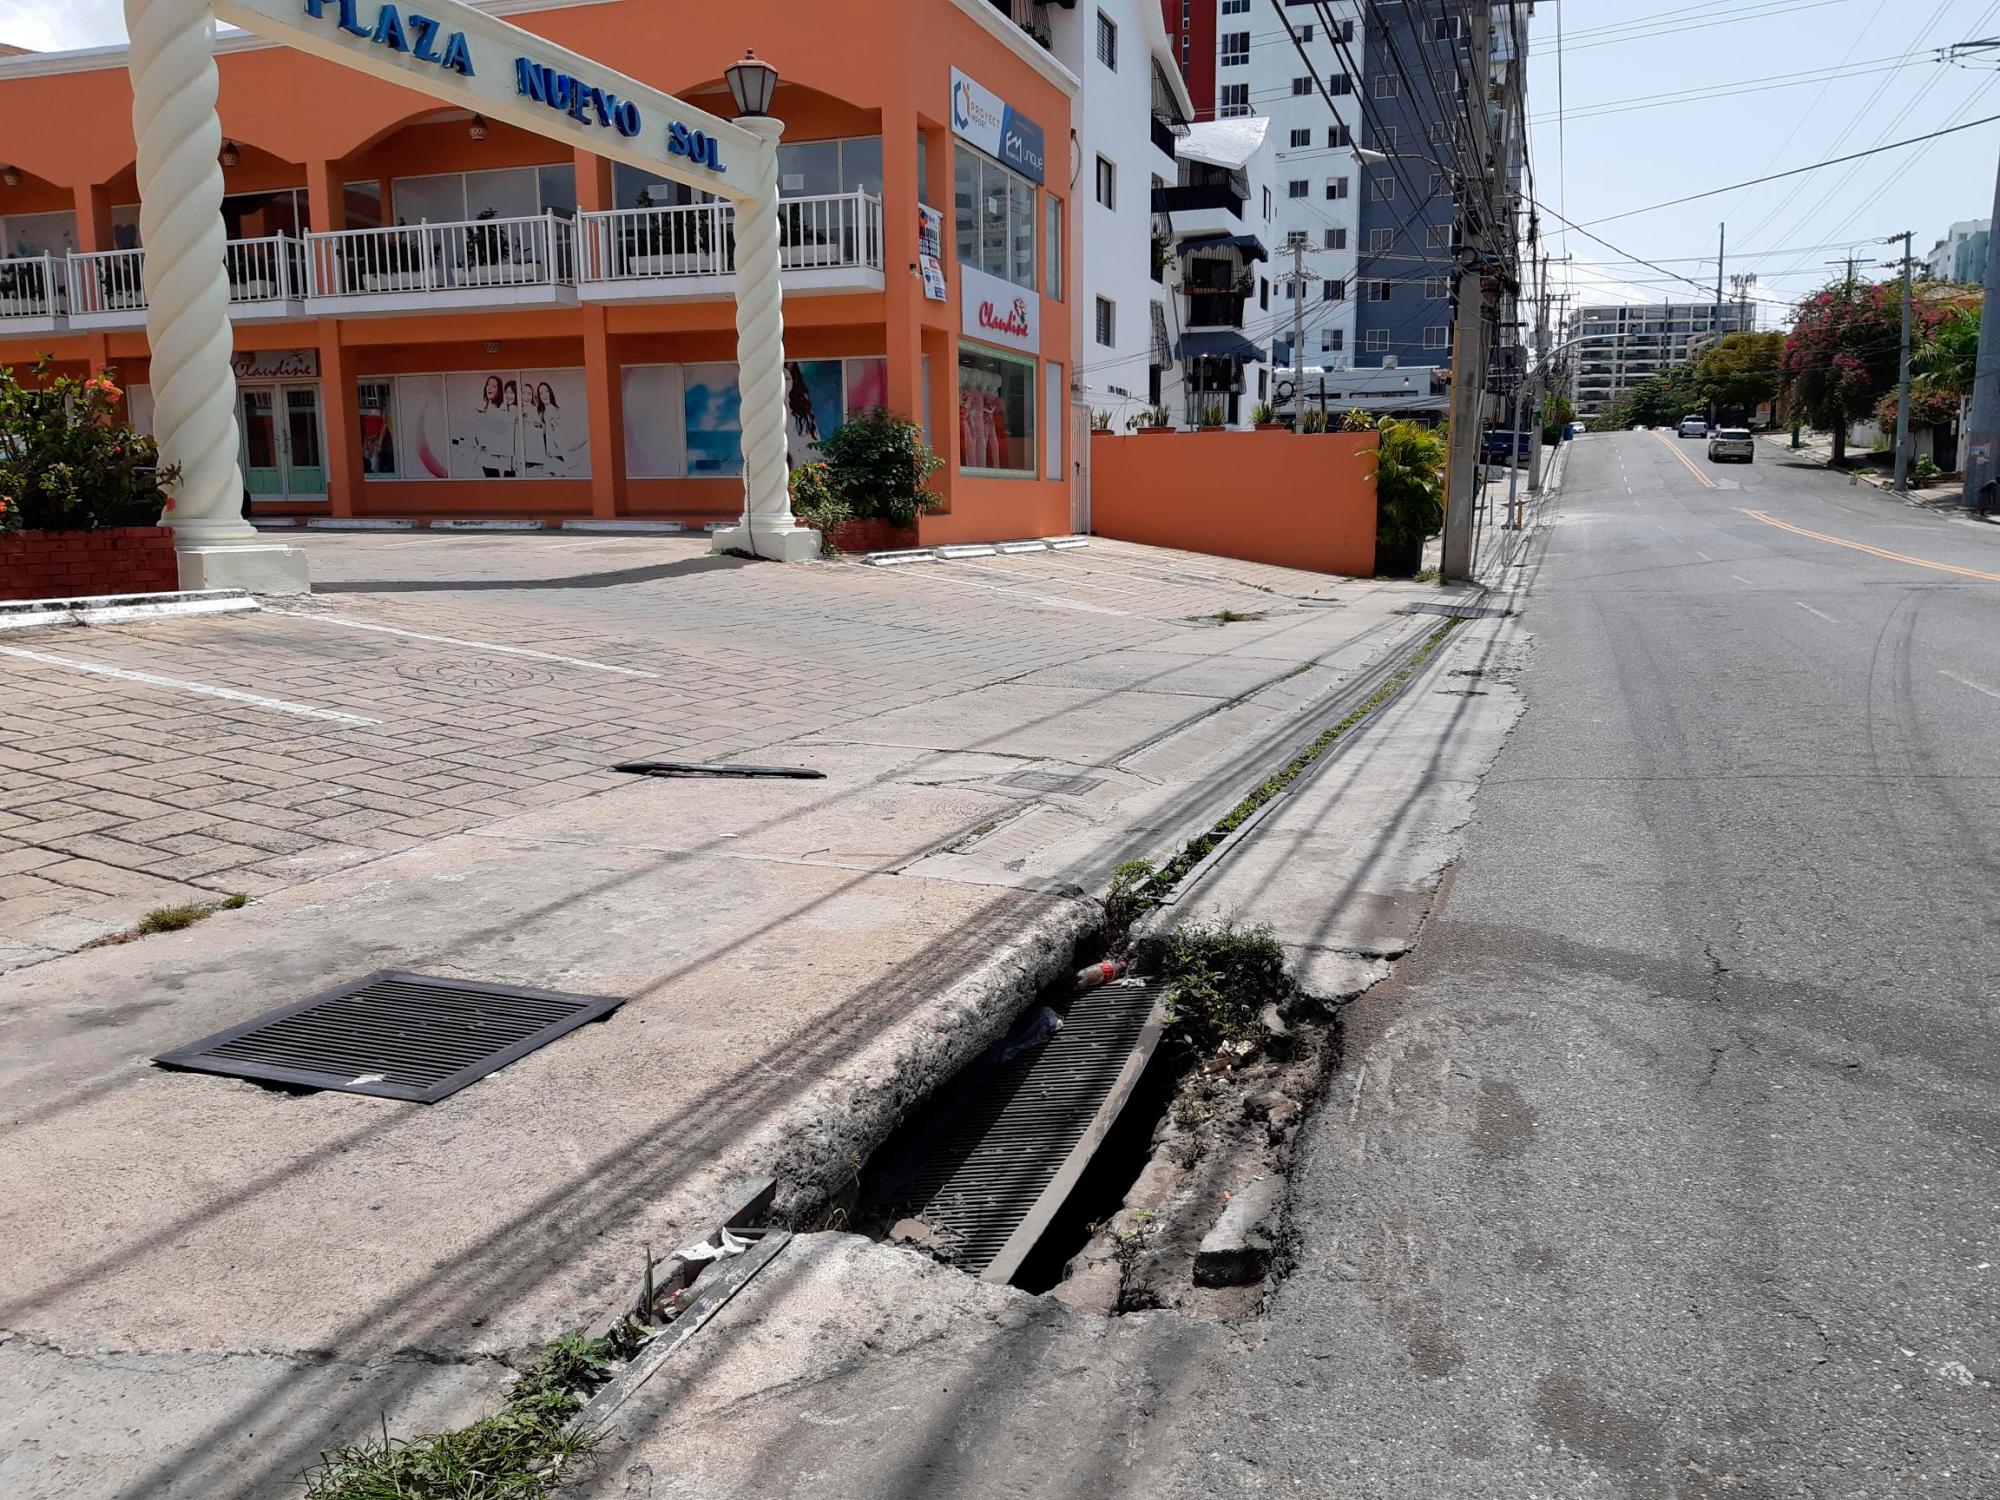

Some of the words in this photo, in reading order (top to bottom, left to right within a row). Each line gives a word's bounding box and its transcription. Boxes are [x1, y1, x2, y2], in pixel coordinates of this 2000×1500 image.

[516, 57, 641, 137] NUEVO
[668, 121, 726, 172] SOL
[971, 102, 1000, 128] PROYECT
[233, 360, 312, 378] Claudine
